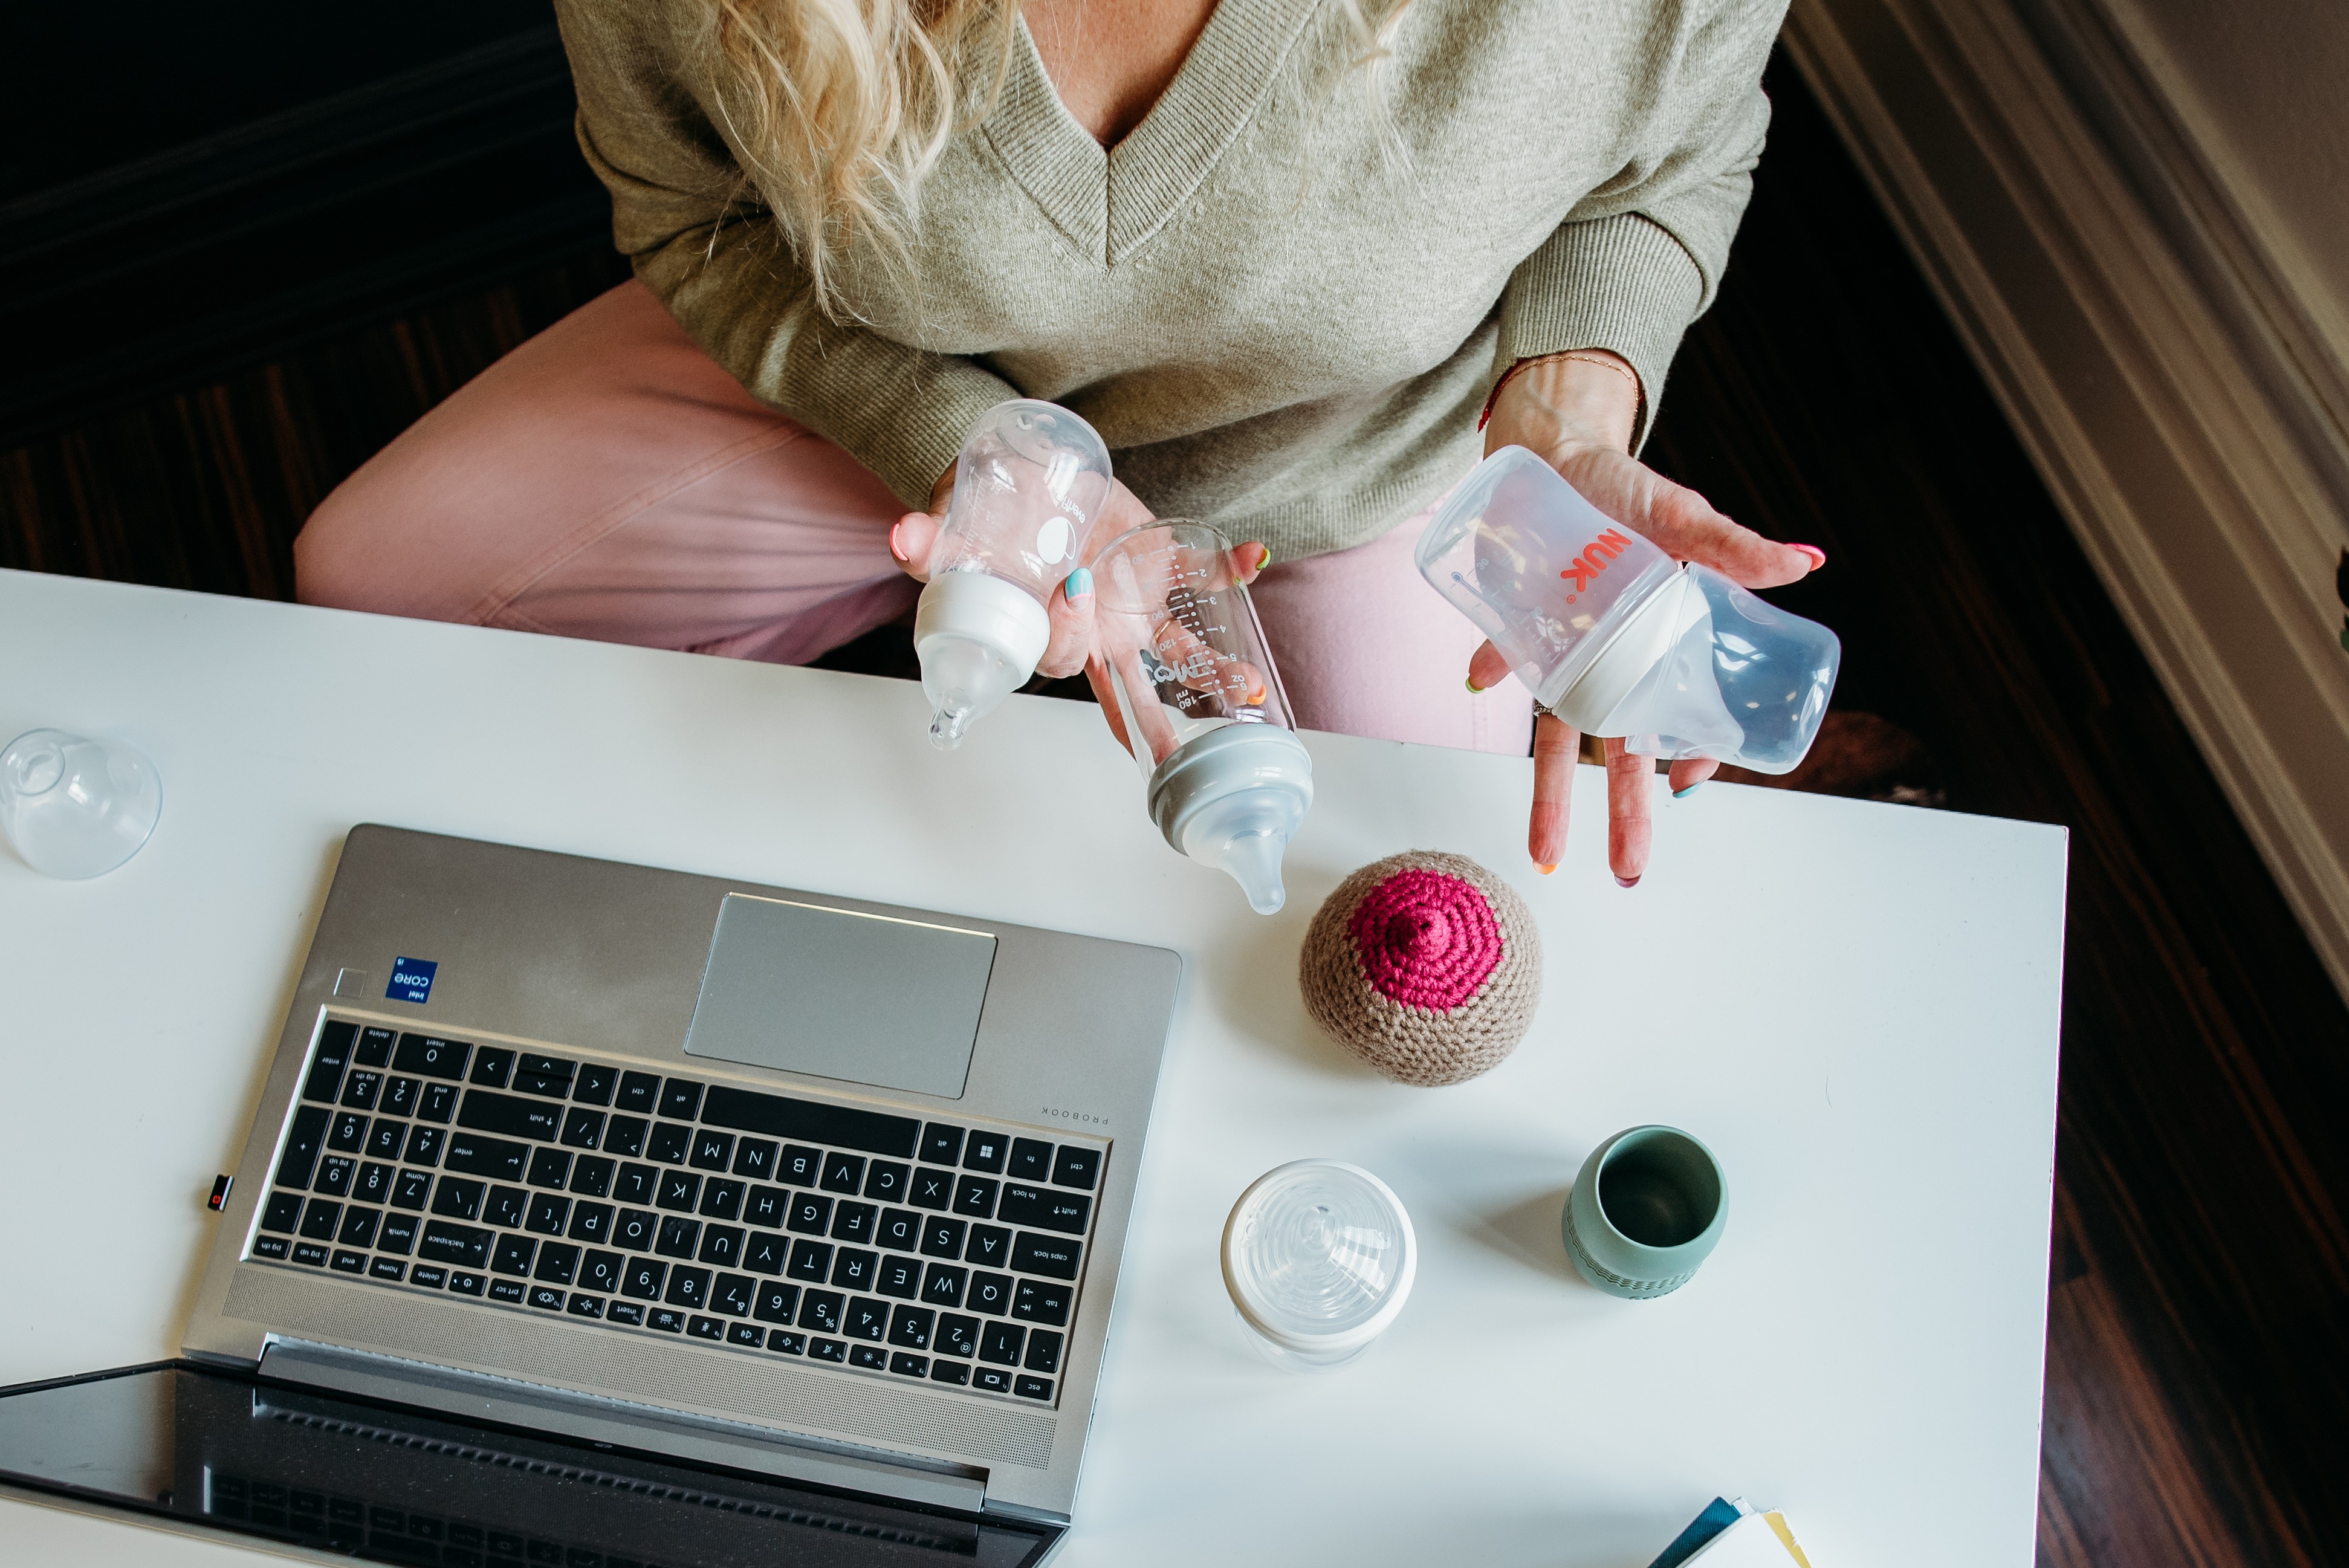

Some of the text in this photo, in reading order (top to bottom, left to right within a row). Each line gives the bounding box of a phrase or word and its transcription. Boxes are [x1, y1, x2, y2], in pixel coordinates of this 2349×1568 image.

[1055, 493, 1086, 524] evenflo
[1190, 542, 1196, 550] 1
[1561, 528, 1633, 593] NUK
[1199, 569, 1207, 577] 2
[1210, 597, 1217, 605] 3
[1220, 625, 1226, 633] 4
[1159, 638, 1176, 652] 120
[1230, 653, 1237, 662] 5
[1240, 682, 1247, 690] 6
[1176, 689, 1188, 701] ml
[1179, 696, 1208, 710] 180
[409, 991, 424, 1001] intel
[368, 1029, 389, 1038] delete
[426, 1038, 445, 1048] insert
[426, 1049, 437, 1062] 0
[356, 1082, 366, 1095] 3
[394, 1088, 404, 1101] 2
[434, 1096, 439, 1108] 1
[530, 1113, 544, 1122] shift
[1041, 1107, 1109, 1125] PROBOOK
[343, 1125, 353, 1138] 6
[578, 1123, 588, 1133] /
[381, 1132, 391, 1145] 5
[420, 1138, 430, 1151] 4
[586, 1135, 592, 1145] ?
[704, 1142, 720, 1158] M
[748, 1150, 762, 1165] N
[793, 1158, 806, 1173] B
[329, 1168, 340, 1181] 9
[406, 1171, 426, 1182] home
[835, 1166, 848, 1181] V
[368, 1175, 378, 1188] 8
[632, 1175, 641, 1190] L
[880, 1173, 893, 1188] C
[406, 1182, 415, 1196] 7
[672, 1182, 686, 1198] K
[925, 1181, 938, 1196] X
[1012, 1189, 1027, 1198] lock
[456, 1191, 460, 1203] \
[716, 1191, 727, 1205] J
[970, 1188, 983, 1204] Z
[502, 1200, 508, 1211] ]
[759, 1197, 773, 1213] H
[1061, 1207, 1077, 1215] shift
[510, 1213, 516, 1223] }
[545, 1208, 551, 1219] [
[803, 1206, 817, 1220] G
[355, 1220, 364, 1231] /
[552, 1220, 558, 1231] {
[585, 1215, 598, 1229] P
[848, 1215, 861, 1229] F
[388, 1227, 409, 1237] numlk
[627, 1222, 641, 1237] O
[893, 1222, 906, 1237] D
[427, 1235, 464, 1249] backspace
[675, 1230, 681, 1244] I
[938, 1229, 950, 1245] S
[271, 1243, 282, 1251] pg
[714, 1237, 728, 1252] U
[983, 1237, 997, 1252] A
[759, 1246, 771, 1260] Y
[1033, 1250, 1049, 1259] lock
[803, 1254, 814, 1268] T
[378, 1263, 398, 1274] home
[595, 1263, 606, 1277] 0
[848, 1261, 861, 1276] R
[418, 1271, 439, 1281] delete
[606, 1277, 612, 1288] )
[640, 1271, 650, 1285] 9
[893, 1269, 906, 1284] E
[649, 1285, 655, 1295] (
[683, 1280, 693, 1293] 8
[934, 1277, 953, 1293] W
[727, 1288, 736, 1301] 7
[983, 1285, 997, 1300] Q
[737, 1301, 745, 1311] &
[771, 1295, 782, 1309] 6
[617, 1305, 637, 1316] insert
[816, 1303, 827, 1317] 5
[825, 1318, 834, 1328] %
[862, 1312, 872, 1324] 4
[871, 1326, 879, 1336] $
[906, 1320, 916, 1333] 3
[916, 1334, 924, 1344] #
[951, 1327, 962, 1341] 2
[960, 1341, 971, 1353] @
[999, 1336, 1004, 1349] 1
[1009, 1351, 1014, 1360] !
